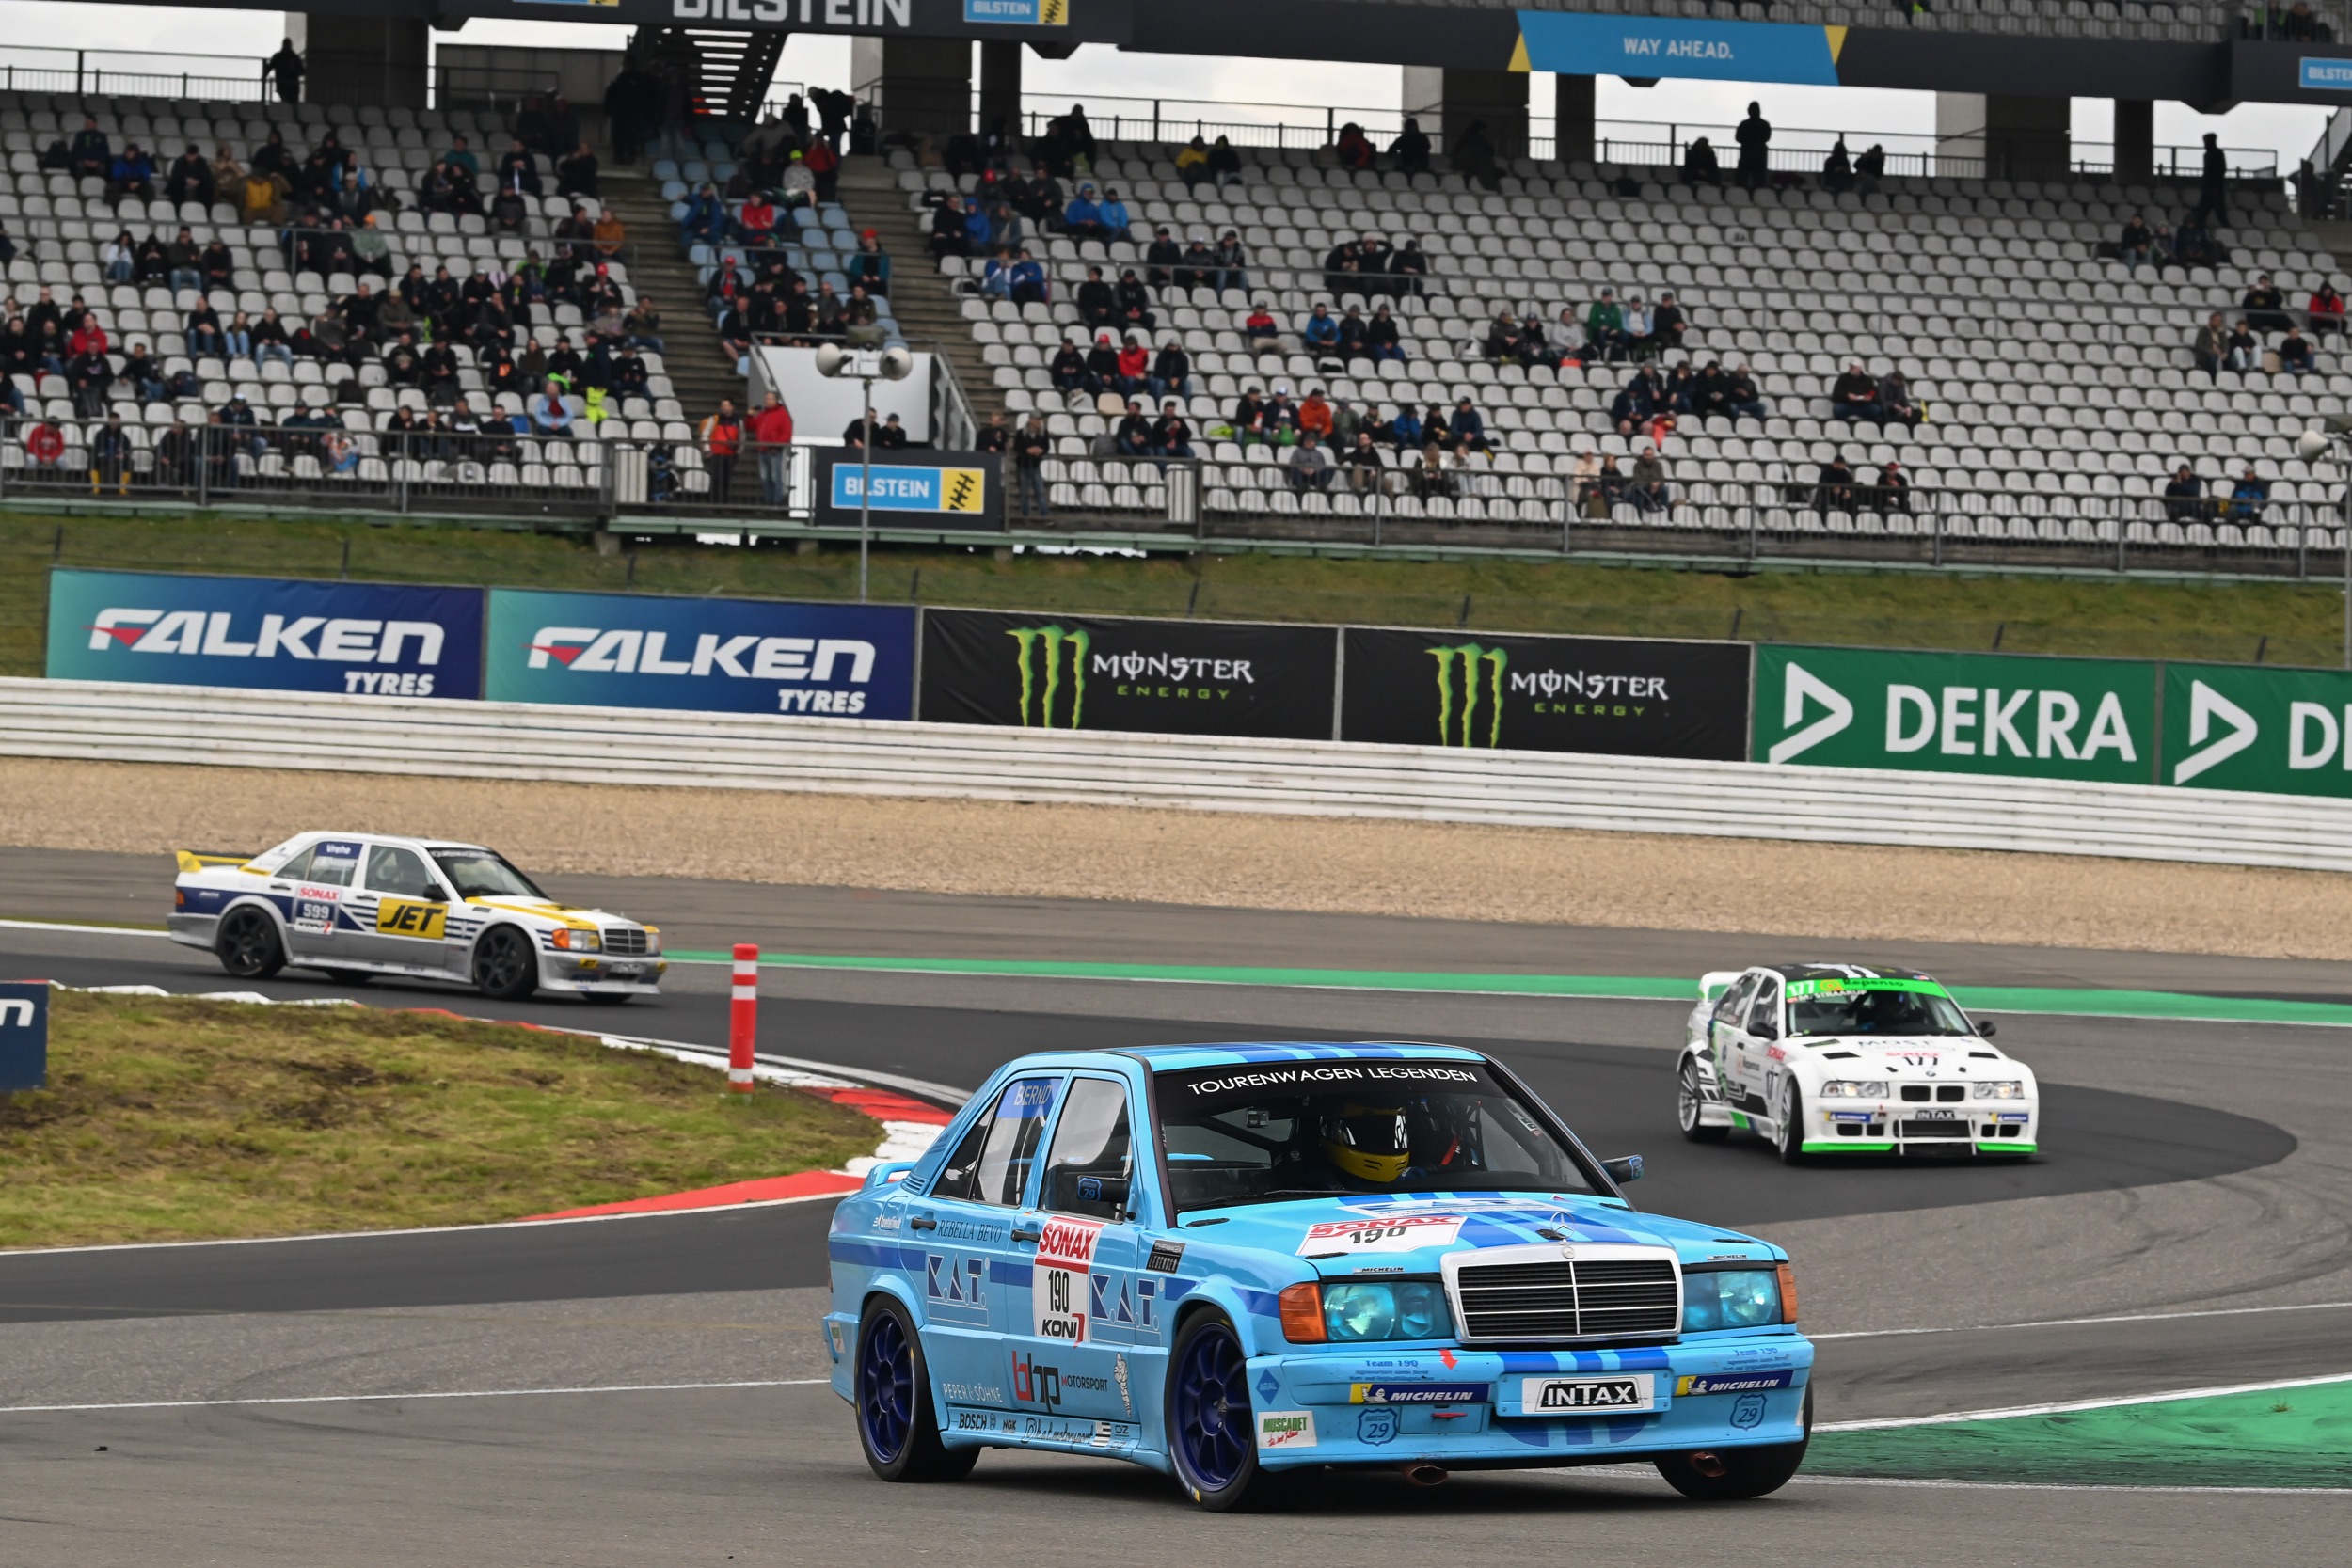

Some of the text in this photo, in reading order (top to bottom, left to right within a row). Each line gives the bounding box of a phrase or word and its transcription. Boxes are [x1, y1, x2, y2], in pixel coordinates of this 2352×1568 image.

[973, 1, 1031, 15] BILSTEIN
[1623, 37, 1734, 59] WAY AHEAD.
[87, 608, 445, 665] FALKEN
[526, 626, 876, 682] FALKEN
[1092, 650, 1255, 684] MONSTER
[344, 671, 435, 696] TYRES
[1117, 685, 1230, 700] ENERGY
[1510, 669, 1669, 700] MONSTER
[778, 689, 866, 714] TYRES
[1534, 702, 1645, 717] ENERGY
[1885, 683, 2137, 762] DEKRA
[2288, 701, 2352, 771] D
[299, 887, 338, 901] SONAX
[302, 903, 330, 919] 599
[380, 904, 444, 932] JET
[1787, 980, 1815, 997] 177
[1187, 1067, 1478, 1096] TOURENWAGEN LEGENDEN
[1013, 1085, 1053, 1106] BERND
[1916, 1110, 1955, 1120] INTAX
[1083, 1188, 1096, 1199] 29
[937, 1219, 1003, 1243] REBELLA BEVO
[1310, 1216, 1450, 1238] SONAX
[1349, 1227, 1407, 1244] 190
[1039, 1223, 1096, 1260] SONAX
[1047, 1269, 1070, 1314] 190
[1041, 1319, 1077, 1338] KONI
[943, 1383, 967, 1401] PEPER
[974, 1382, 1004, 1403] SÖHNE
[1061, 1374, 1108, 1392] MOTORSPORT
[1709, 1378, 1780, 1391] MICHELIN
[1390, 1391, 1473, 1401] MICHELIN
[1547, 1384, 1635, 1405] INTAX
[959, 1412, 988, 1432] BOSCH
[1002, 1418, 1017, 1431] NGK
[1263, 1416, 1308, 1433] MUSCADET
[1737, 1407, 1758, 1423] 29
[1114, 1424, 1130, 1434] OZ
[1366, 1422, 1390, 1439] 29
